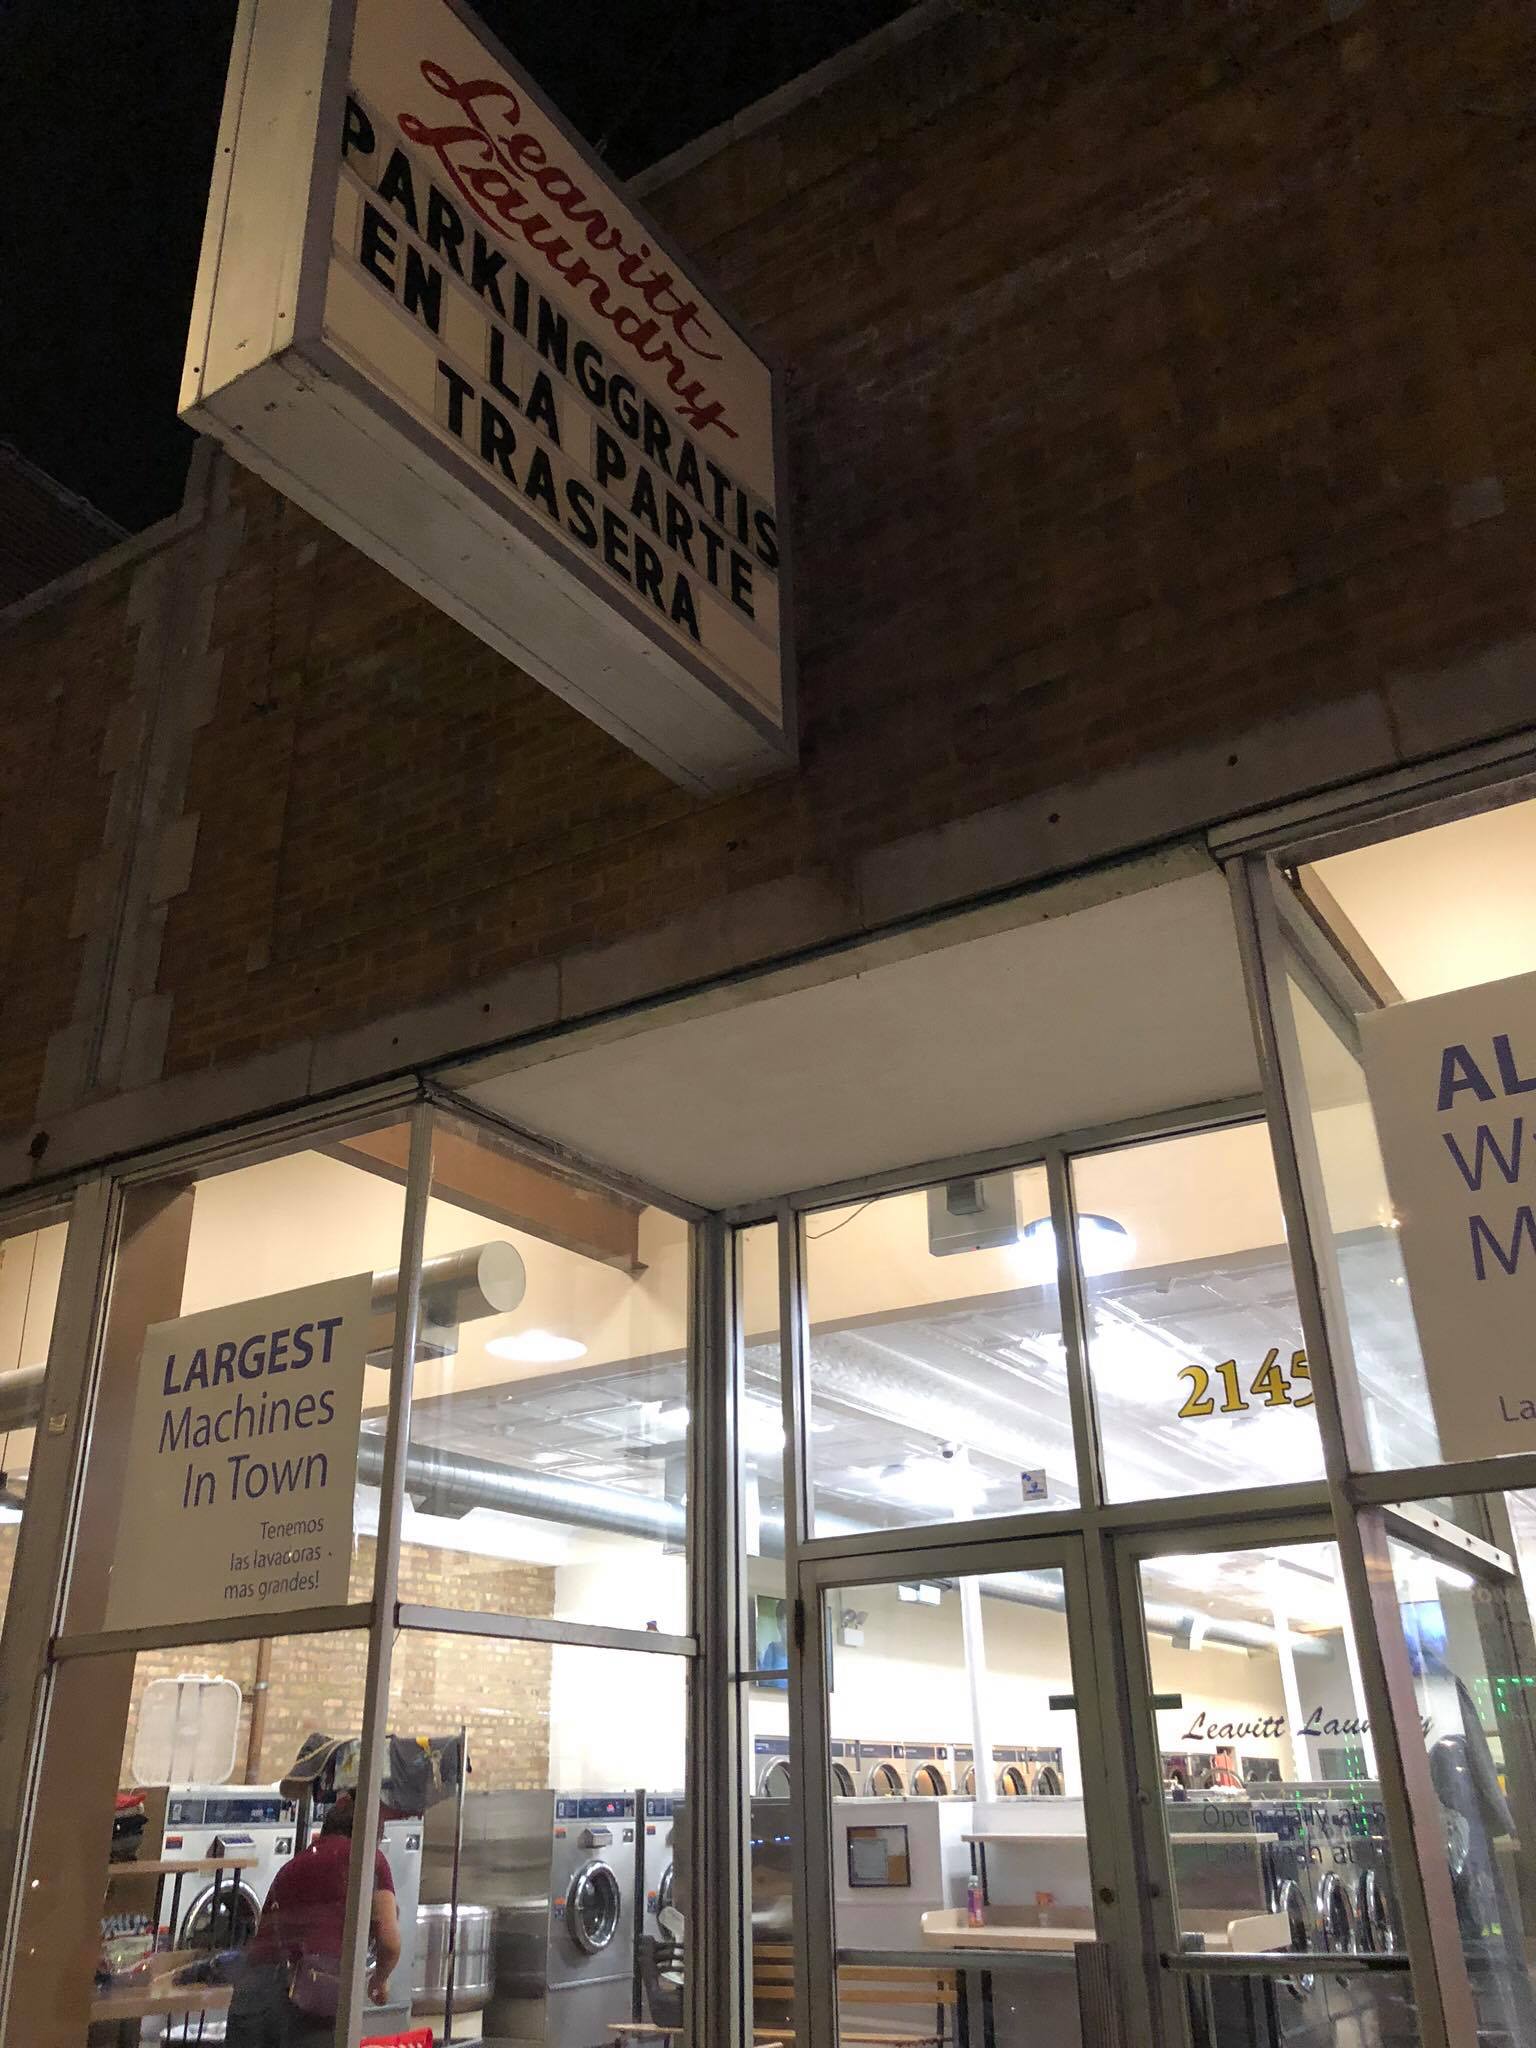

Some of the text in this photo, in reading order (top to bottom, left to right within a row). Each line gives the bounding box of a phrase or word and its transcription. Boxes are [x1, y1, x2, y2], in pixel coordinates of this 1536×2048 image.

[420, 60, 723, 361] Leavitt
[397, 113, 739, 439] Laundry
[359, 200, 756, 620] EN LA PARTE
[437, 359, 701, 643] TRASERA
[1442, 1117, 1536, 1193] W
[162, 1316, 344, 1396] LARGEST
[1177, 1347, 1315, 1419] 2145
[157, 1389, 336, 1454] Machines
[182, 1452, 329, 1508] In Town
[229, 1544, 322, 1571] las lavadoras
[260, 1516, 325, 1541] Tenemos
[223, 1572, 320, 1601] mas grandes!
[1181, 1711, 1285, 1741] Leavitt
[1202, 1803, 1260, 1829] Open
